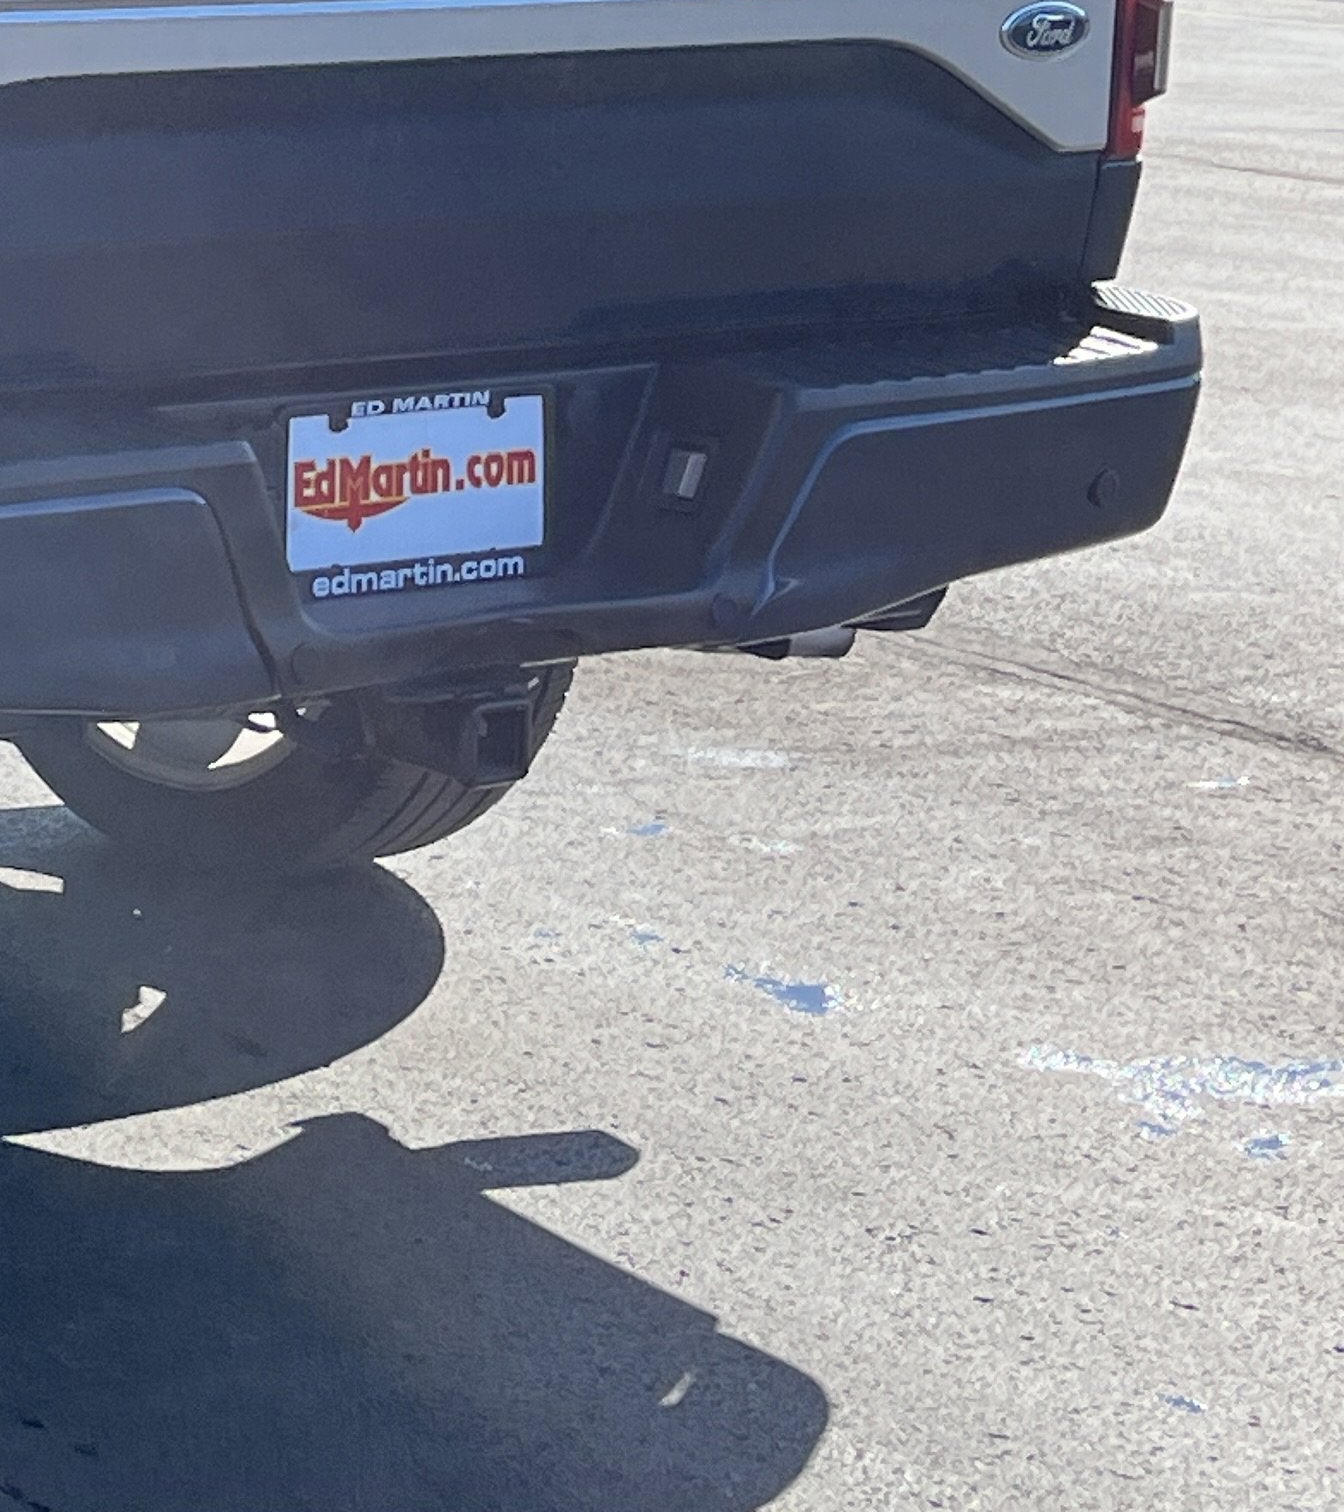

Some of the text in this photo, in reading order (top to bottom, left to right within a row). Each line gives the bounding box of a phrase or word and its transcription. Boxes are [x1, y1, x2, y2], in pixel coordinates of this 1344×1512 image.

[351, 390, 490, 418] ED MARTIN
[312, 554, 525, 598] edmartin.com
